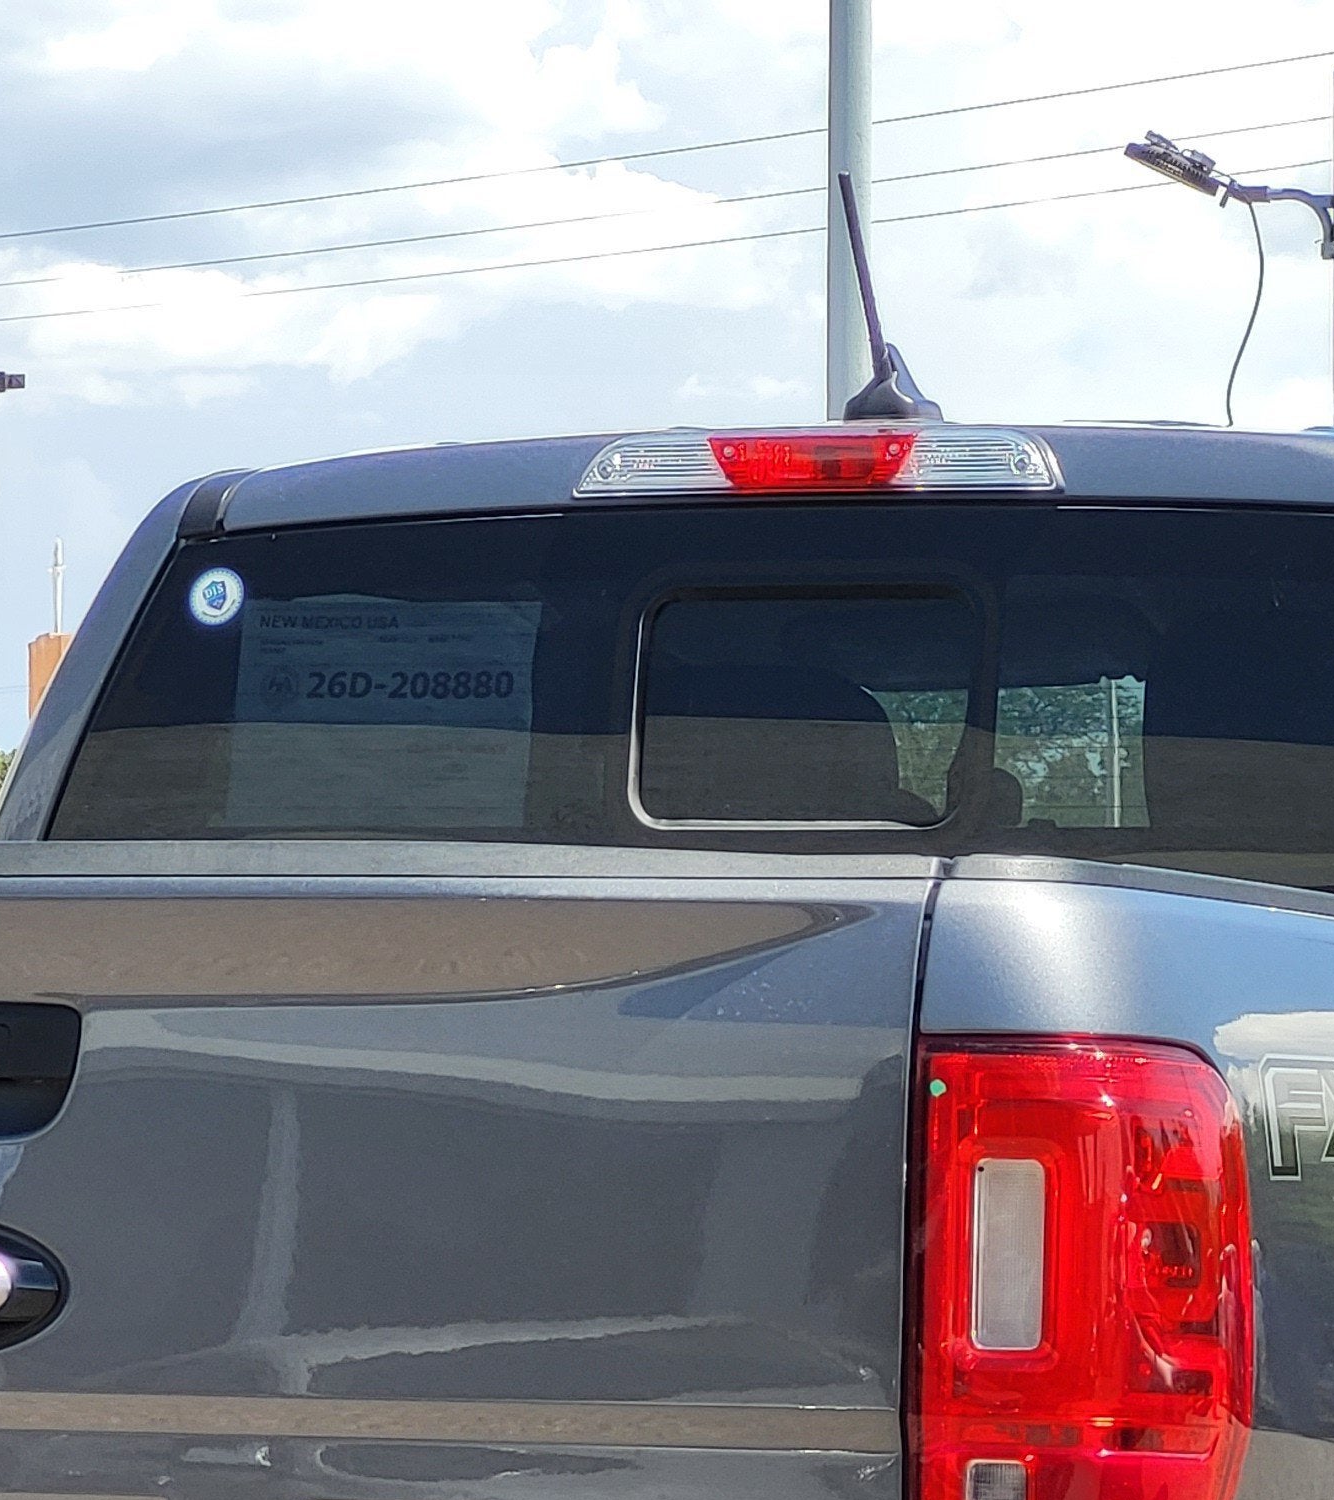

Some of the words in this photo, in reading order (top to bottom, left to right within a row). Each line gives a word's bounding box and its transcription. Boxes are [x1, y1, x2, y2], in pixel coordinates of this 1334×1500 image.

[260, 616, 298, 628] NEW
[302, 616, 363, 629] MEXICO
[368, 616, 399, 629] USA
[306, 670, 514, 699] 26D-208880
